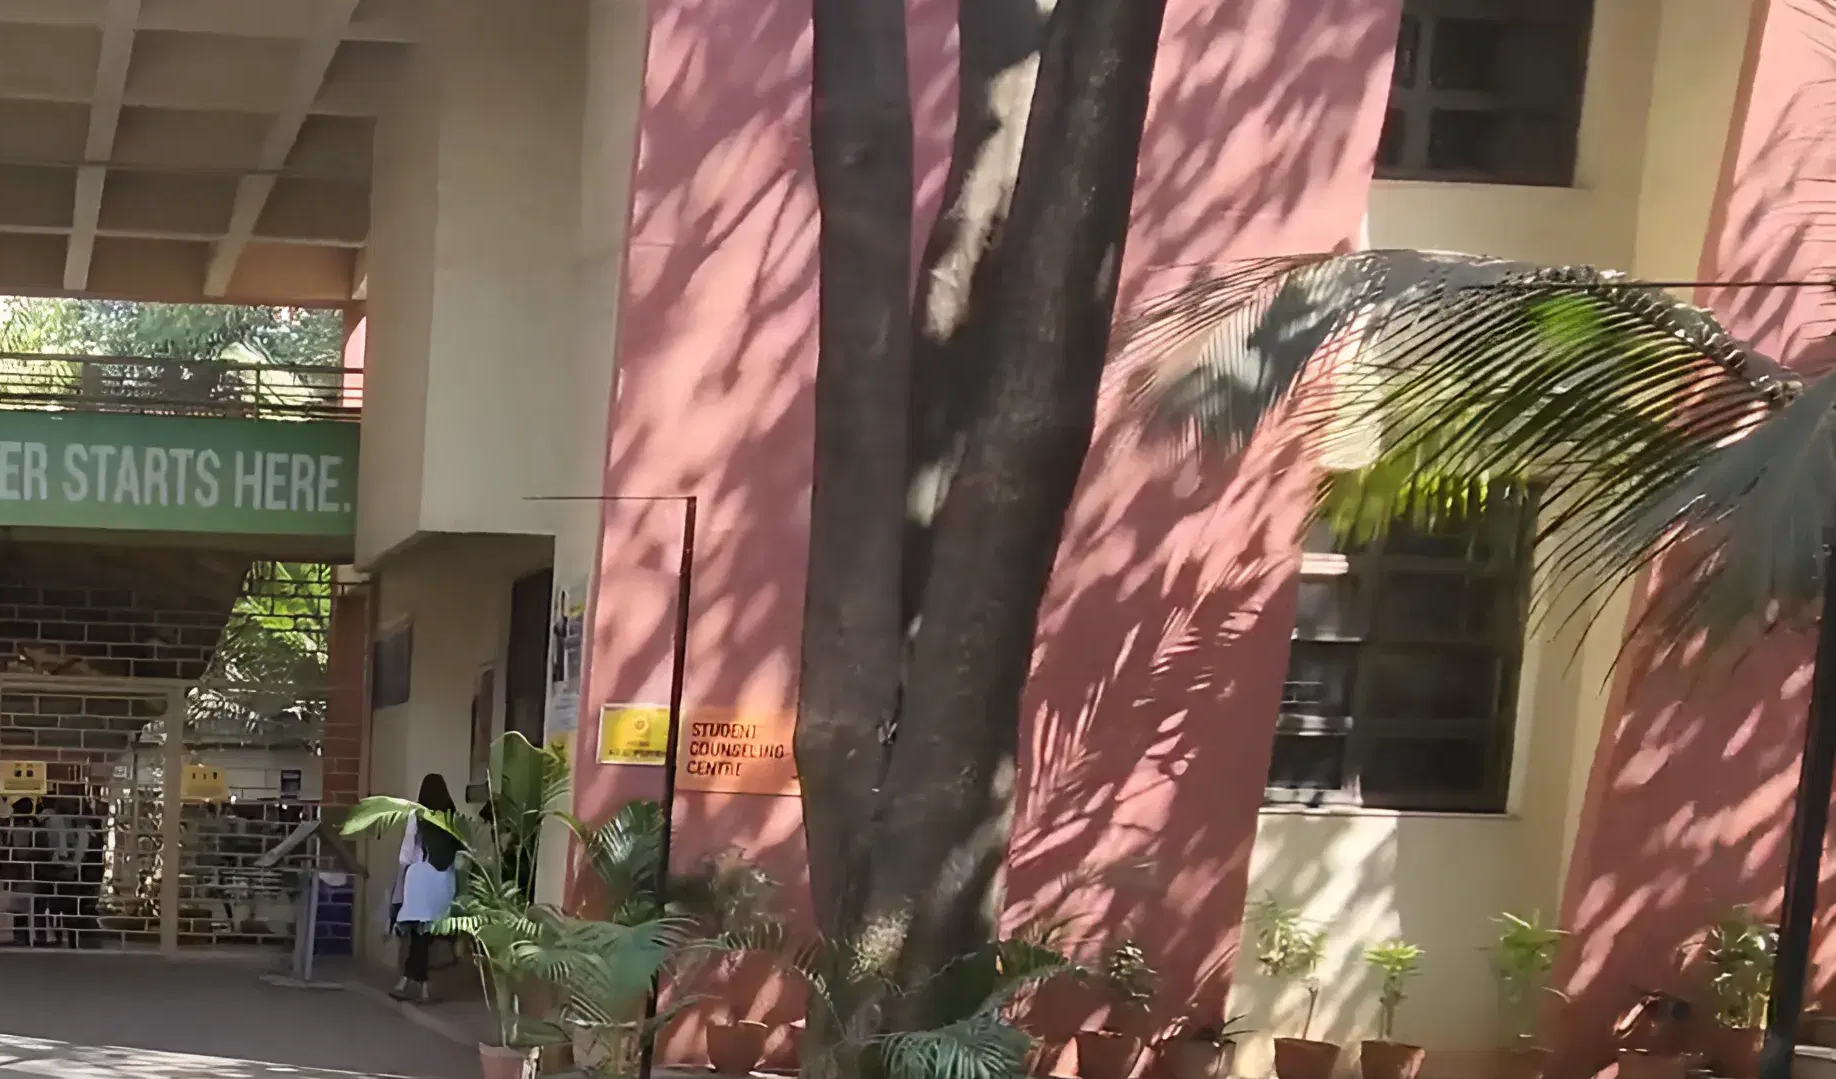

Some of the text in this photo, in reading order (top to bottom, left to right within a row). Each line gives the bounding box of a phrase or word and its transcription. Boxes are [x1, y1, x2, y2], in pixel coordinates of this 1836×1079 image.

[62, 443, 221, 509] STARTS
[234, 451, 351, 513] HERE.
[692, 722, 756, 738] STUDENT
[689, 741, 784, 759] COUNSELING
[687, 760, 742, 776] CENTRE
